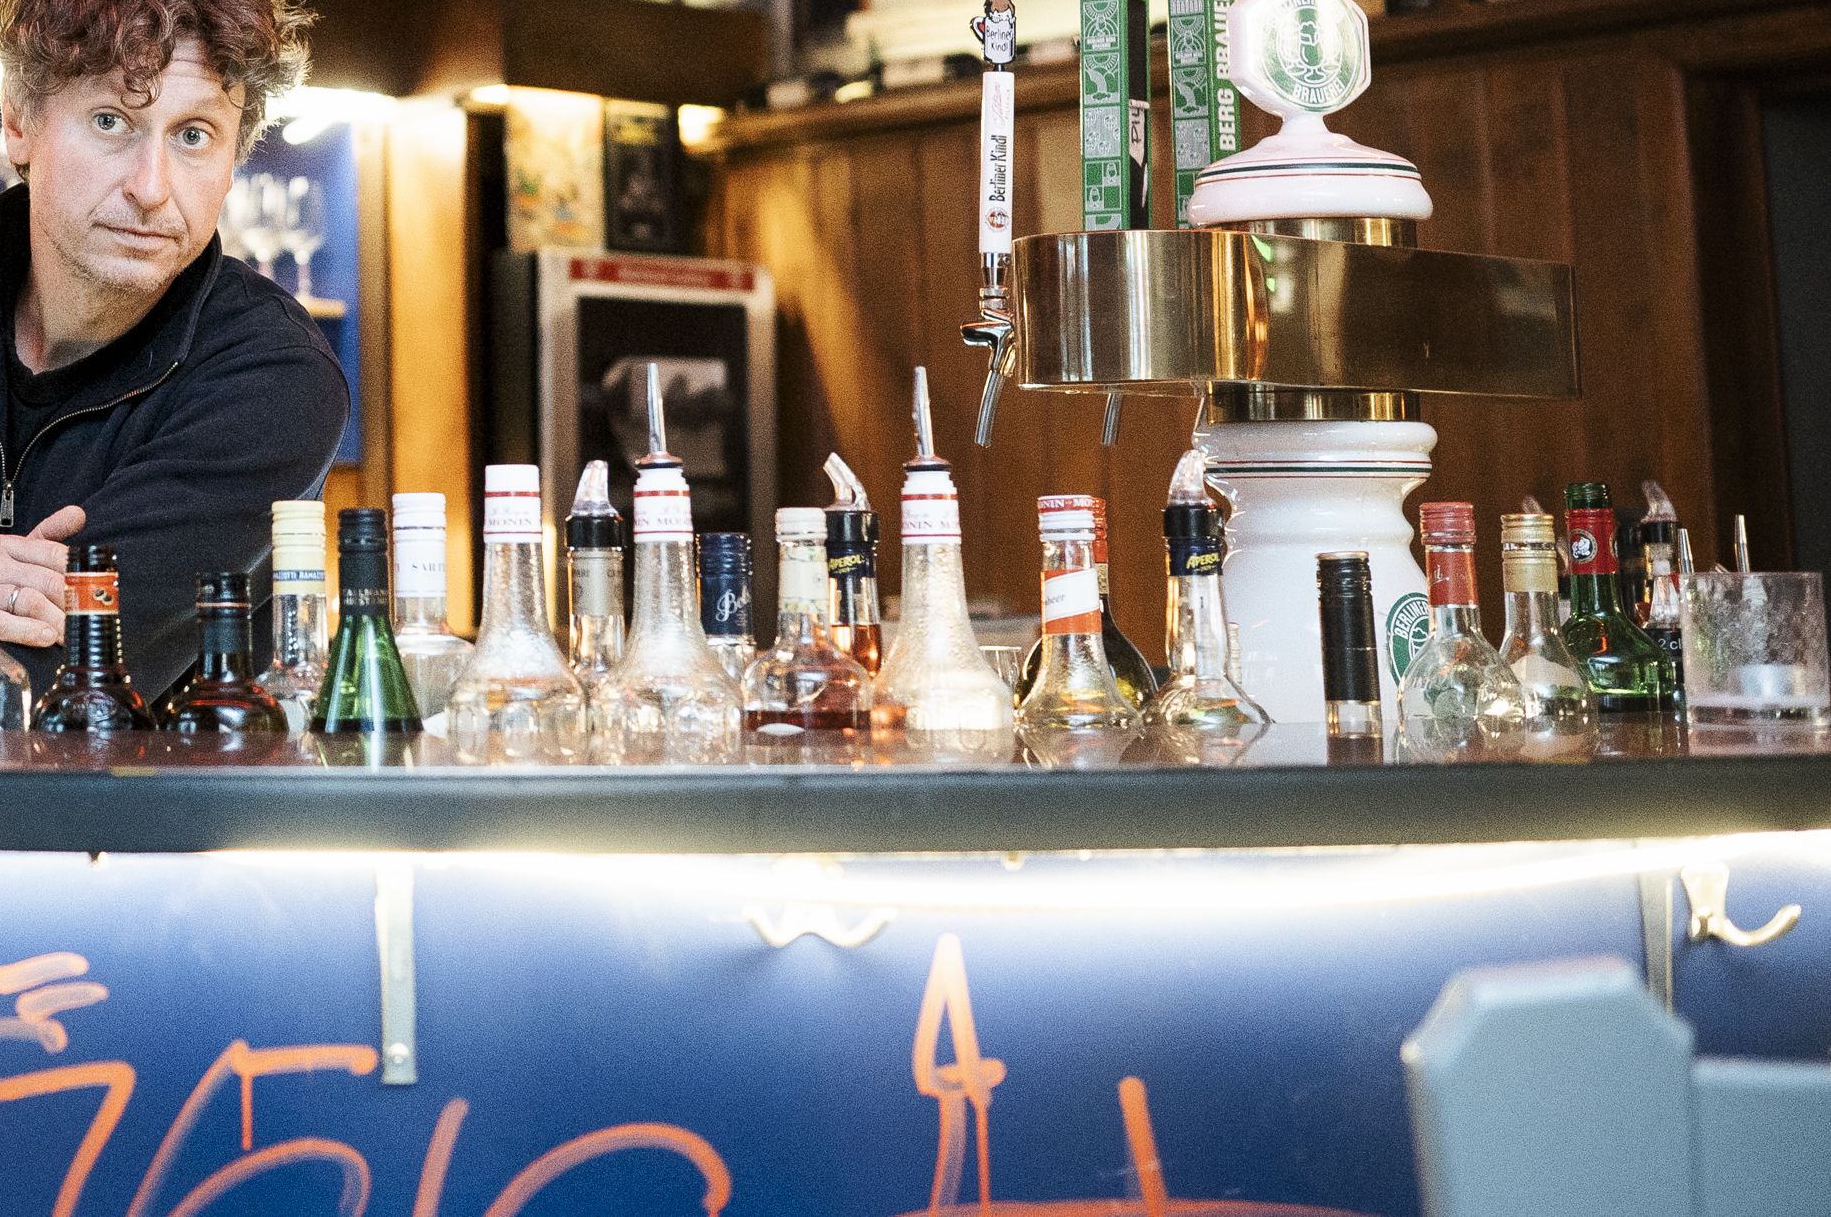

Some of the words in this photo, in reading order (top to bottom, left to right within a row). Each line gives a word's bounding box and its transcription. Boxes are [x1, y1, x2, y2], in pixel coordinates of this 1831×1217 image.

[986, 24, 1013, 40] Berliner
[991, 42, 1009, 52] Kindl
[1291, 79, 1346, 104] BRAUEREI
[1218, 87, 1236, 151] BERG
[989, 135, 1008, 162] Kindl
[988, 164, 1006, 202] Berliner
[1185, 552, 1220, 570] APEROL
[1658, 637, 1669, 650] 2
